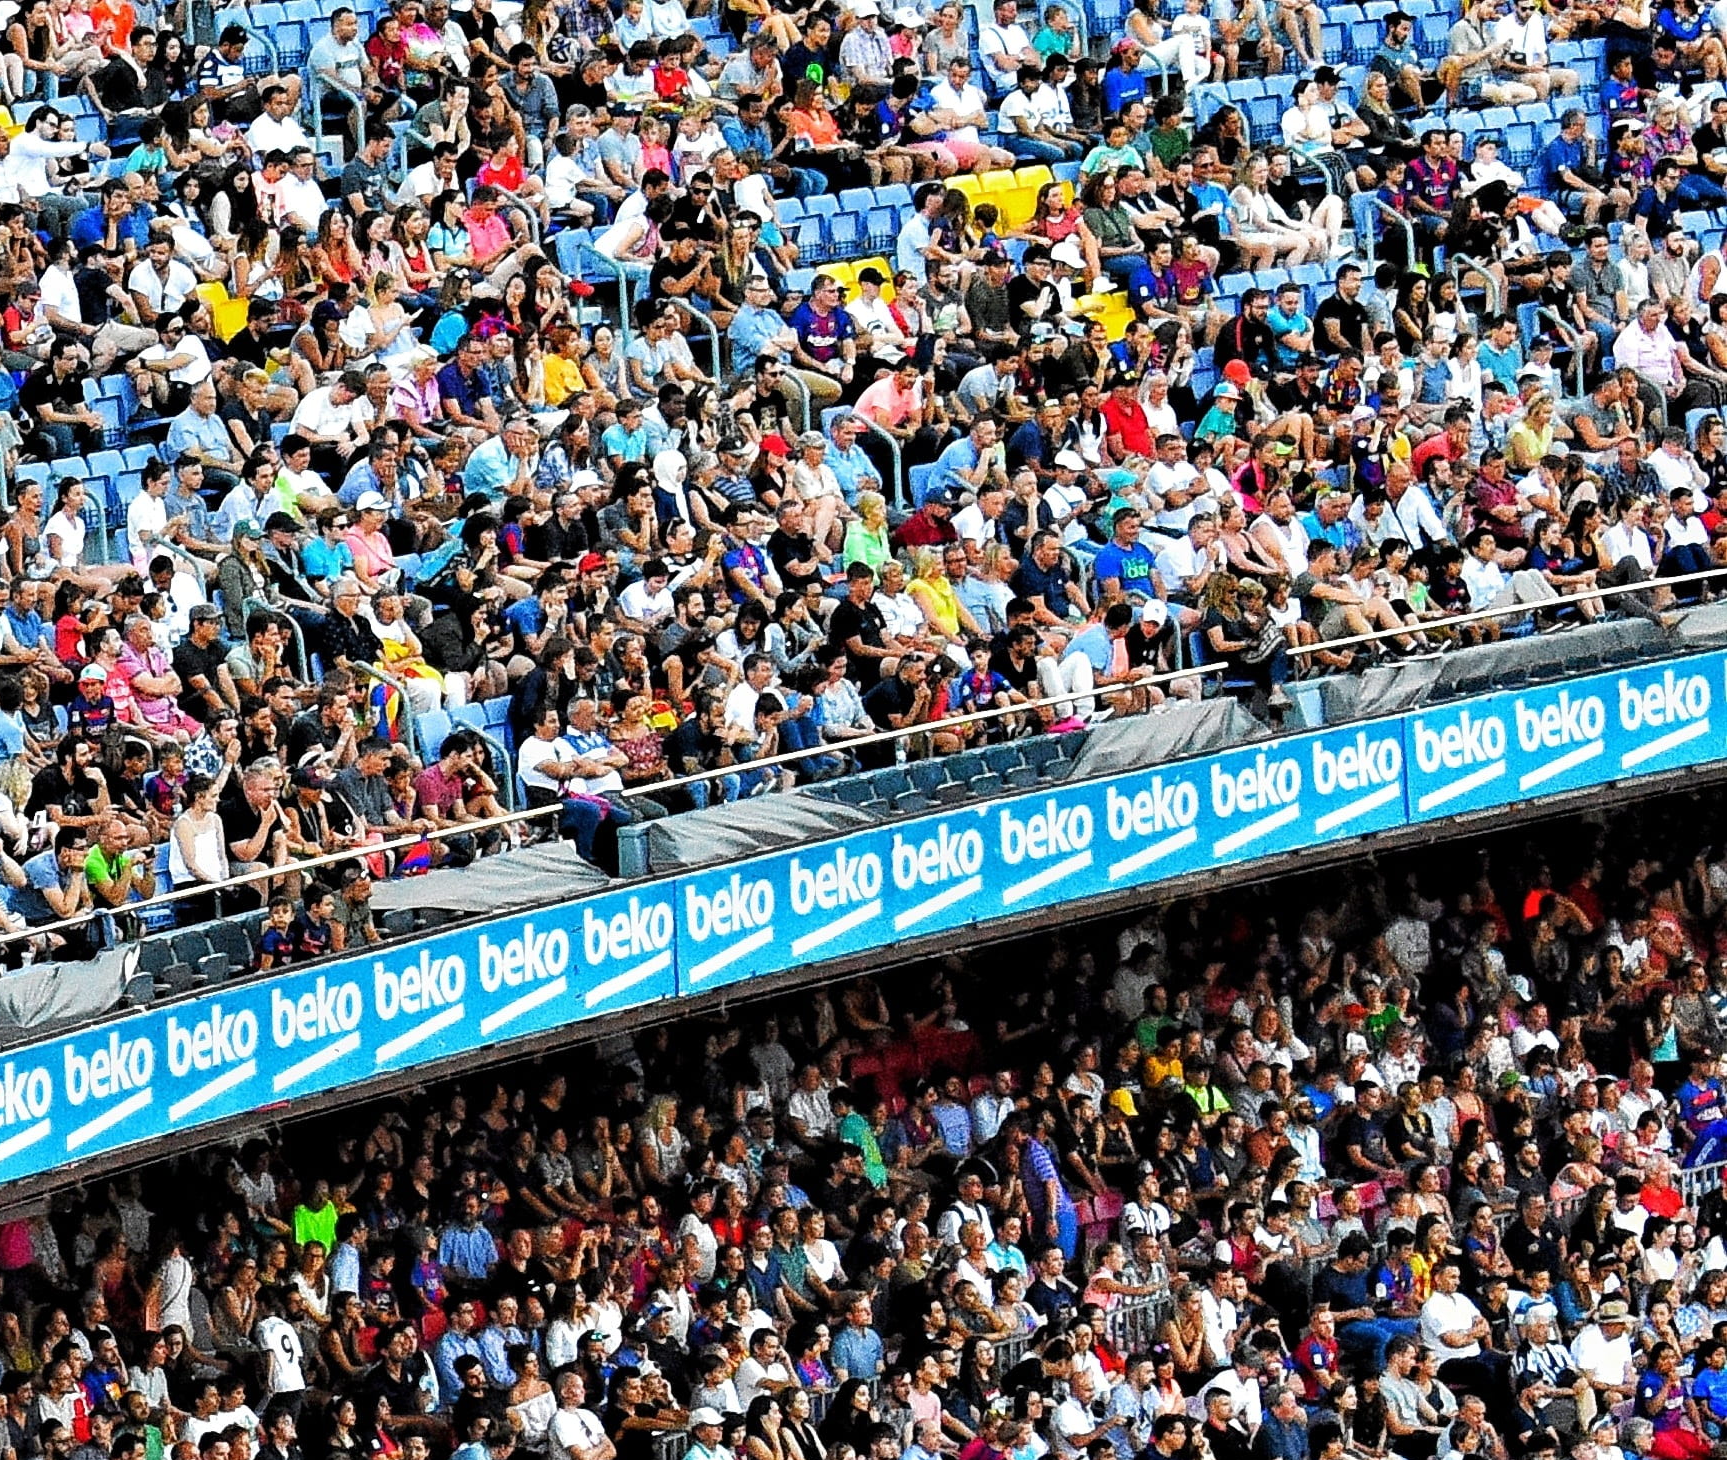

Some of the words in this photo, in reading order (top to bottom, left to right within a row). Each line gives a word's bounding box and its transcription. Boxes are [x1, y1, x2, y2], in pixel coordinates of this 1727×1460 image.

[64, 1031, 154, 1106] beko
[167, 1003, 258, 1078] beko
[271, 975, 363, 1049] beko
[374, 949, 466, 1021] beko
[479, 922, 570, 994] beko
[583, 896, 674, 966] beko
[685, 873, 775, 943] beko
[790, 846, 883, 916] beko
[892, 822, 984, 891] beko
[1000, 798, 1093, 865] beko
[1107, 775, 1199, 842] beko
[1210, 752, 1302, 819] beko
[1312, 731, 1402, 796] beko
[1414, 709, 1506, 774] beko
[1515, 690, 1605, 753] beko
[1618, 669, 1711, 732] beko
